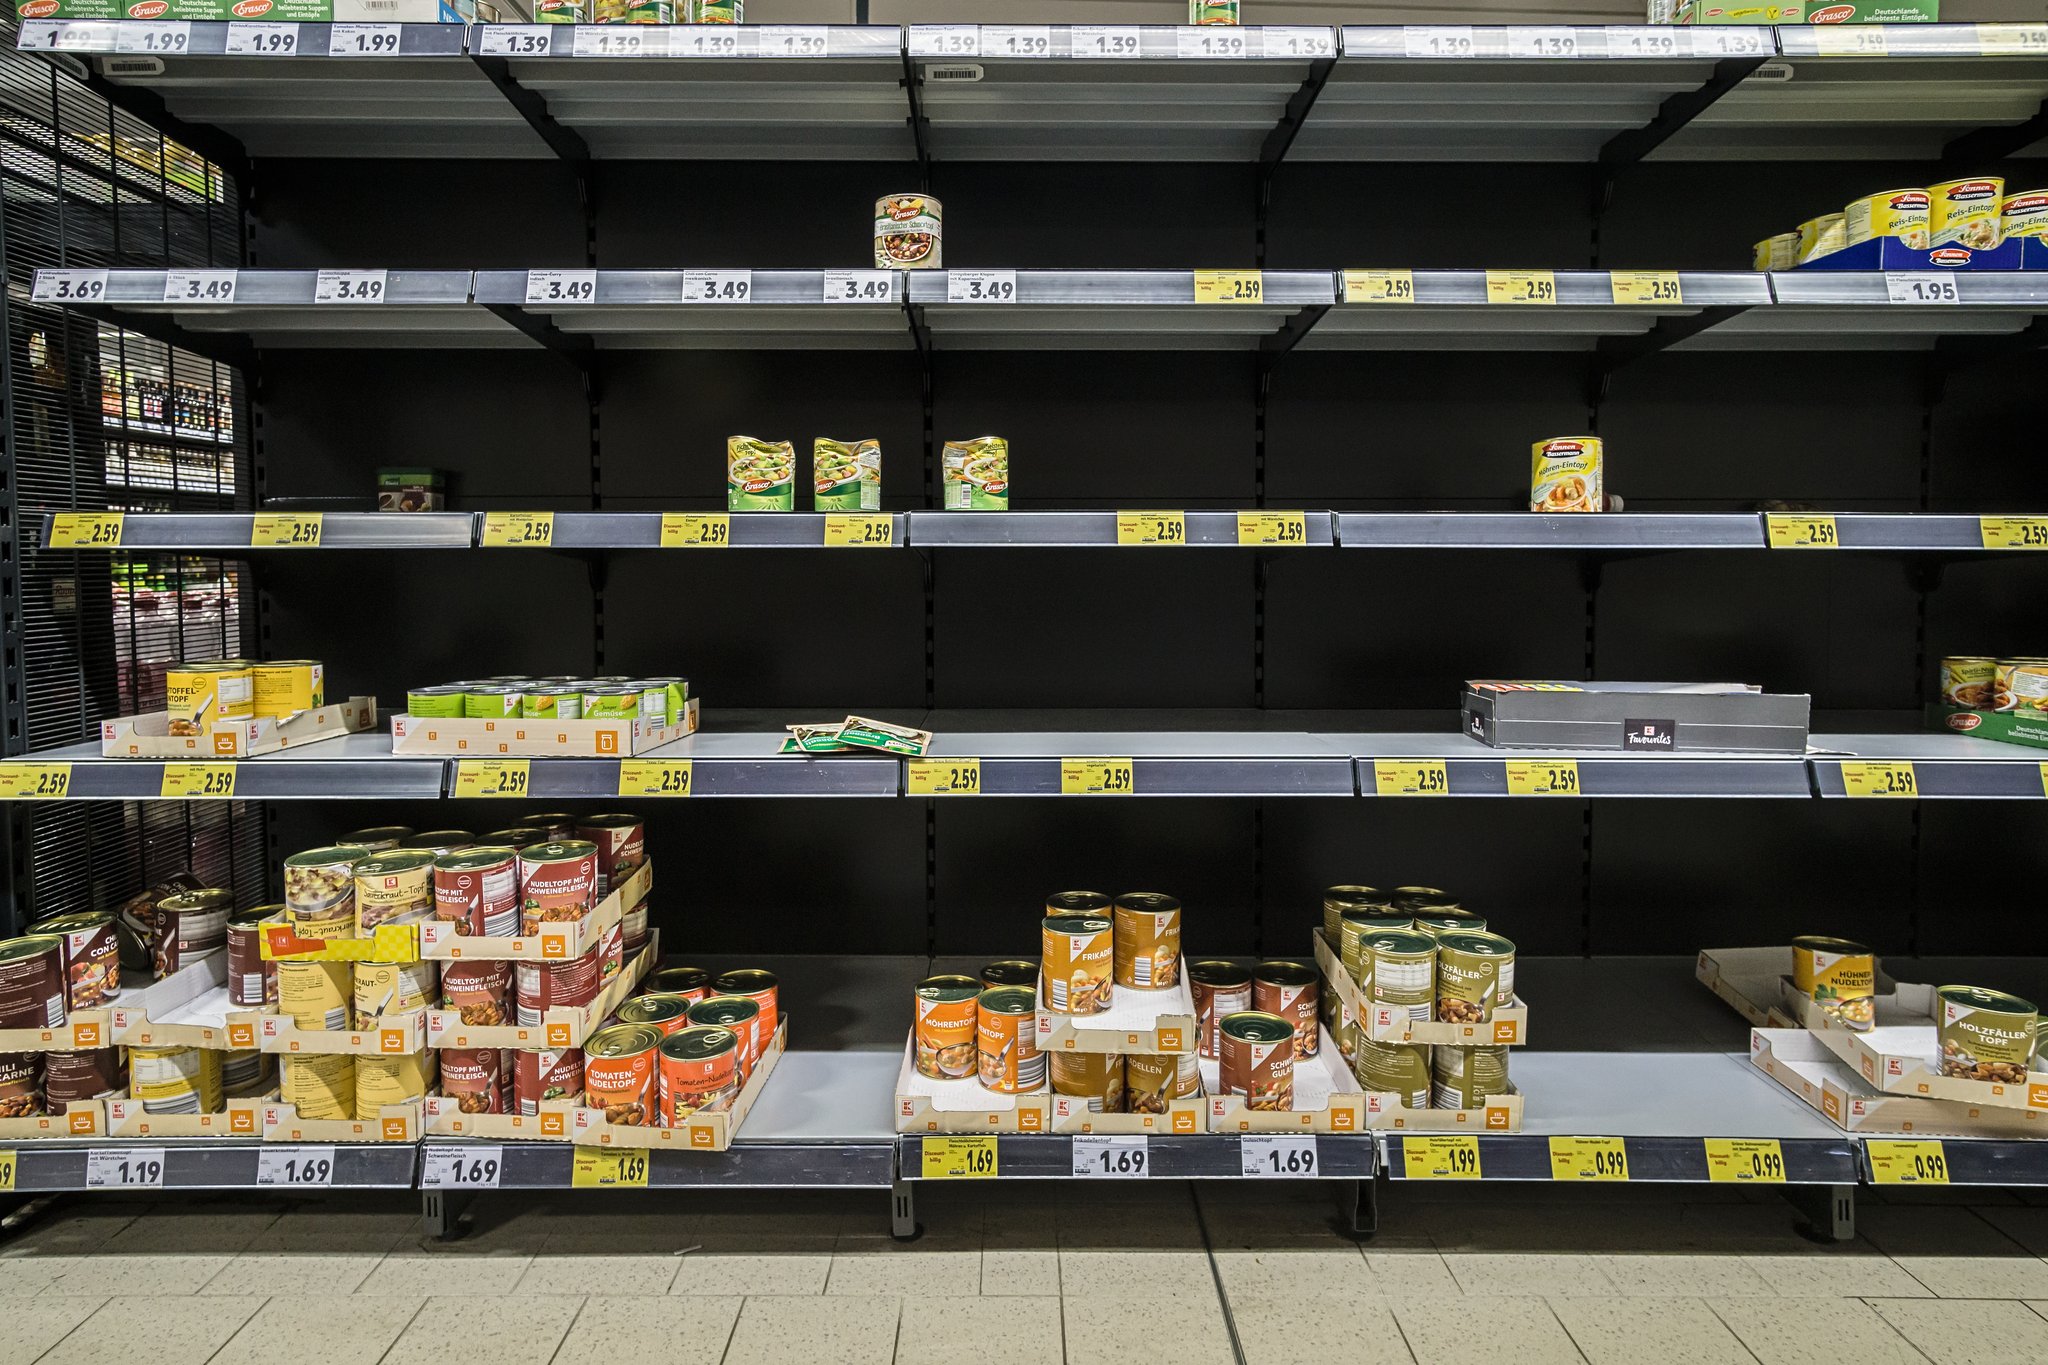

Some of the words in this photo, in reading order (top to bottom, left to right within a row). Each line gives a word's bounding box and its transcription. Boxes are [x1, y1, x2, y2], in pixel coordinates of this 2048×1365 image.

[24, 1, 57, 16] Erasco
[132, 1, 167, 17] Erasco
[236, 1, 270, 15] Erasco
[1816, 10, 1849, 22] Erasco
[144, 33, 186, 49] 1.99
[252, 34, 295, 51] 1.99
[355, 34, 397, 51] 1.99
[507, 37, 548, 52] 1.39
[599, 37, 640, 52] 1.39
[694, 38, 735, 53] 1.39
[784, 37, 825, 53] 1.39
[934, 36, 975, 52] 1.39
[1006, 37, 1047, 53] 1.39
[1096, 37, 1137, 52] 1.39
[1201, 38, 1242, 53] 1.39
[1430, 38, 1471, 54] 1.39
[1533, 38, 1574, 54] 1.39
[1632, 38, 1673, 53] 1.39
[1717, 36, 1759, 52] 1.39
[895, 209, 918, 219] Erasco
[1947, 204, 1995, 220] Reis-Eintopf
[1889, 214, 1929, 229] Reis-Eintopf
[57, 281, 103, 298] 3.69
[187, 281, 233, 298] 3.49
[338, 281, 382, 298] 3.49
[549, 282, 593, 298] 3.49
[705, 282, 748, 298] 3.49
[846, 282, 889, 298] 3.49
[970, 282, 1013, 299] 3.49
[1235, 281, 1259, 298] 2.59
[1386, 280, 1411, 296] 2.59
[1527, 282, 1552, 298] 2.59
[1652, 282, 1678, 298] 2.59
[1913, 282, 1955, 300] 1.95
[1539, 461, 1588, 476] Möhren-Eintopf
[745, 481, 771, 491] Erasco
[92, 524, 119, 542] 2.59
[293, 524, 318, 542] 2.59
[524, 523, 550, 541] 2.59
[701, 524, 726, 542] 2.59
[865, 524, 890, 541] 2.59
[1157, 522, 1182, 541] 2.59
[1277, 522, 1303, 541] 2.59
[1809, 524, 1834, 543] 2.59
[2022, 526, 2048, 544] 2.59
[1950, 716, 1978, 726] Erasco
[1628, 732, 1671, 745] Favourites
[37, 774, 66, 793] 2.59
[204, 773, 231, 793] 2.59
[498, 771, 526, 791] 2.59
[662, 771, 688, 790] 2.59
[951, 769, 977, 788] 2.59
[1104, 769, 1130, 788] 2.59
[1417, 770, 1444, 790] 2.59
[1549, 770, 1575, 789] 2.59
[1885, 771, 1913, 792] 2.59
[527, 882, 589, 895] SCHWEINEFLEISCH
[530, 879, 568, 888] NUDELTOPF
[570, 876, 585, 885] MIT
[364, 883, 425, 900] Sauerkraut-Topf
[90, 946, 108, 957] CON
[443, 979, 505, 991] SCHWEINEFLEISCH
[445, 976, 485, 985] NUDELTOPF
[486, 973, 500, 982] MIT
[1443, 972, 1463, 983] TOPF
[1959, 1021, 2028, 1039] HOLZFÄLLER-
[1979, 1034, 2008, 1046] TOPF
[590, 1069, 635, 1080] TOMATEN-
[588, 1078, 637, 1088] NUDELTOPF
[967, 1150, 993, 1172] 1.69
[1100, 1151, 1145, 1173] 1.69
[1269, 1150, 1314, 1172] 1.69
[1449, 1149, 1475, 1172] 1.99
[1596, 1151, 1623, 1175] 0.99
[1752, 1153, 1781, 1177] 0.99
[1915, 1155, 1943, 1178] 0.99
[118, 1161, 160, 1183] 1.19
[285, 1160, 330, 1182] 1.69
[452, 1160, 498, 1182] 1.69
[618, 1158, 645, 1181] 1.69
